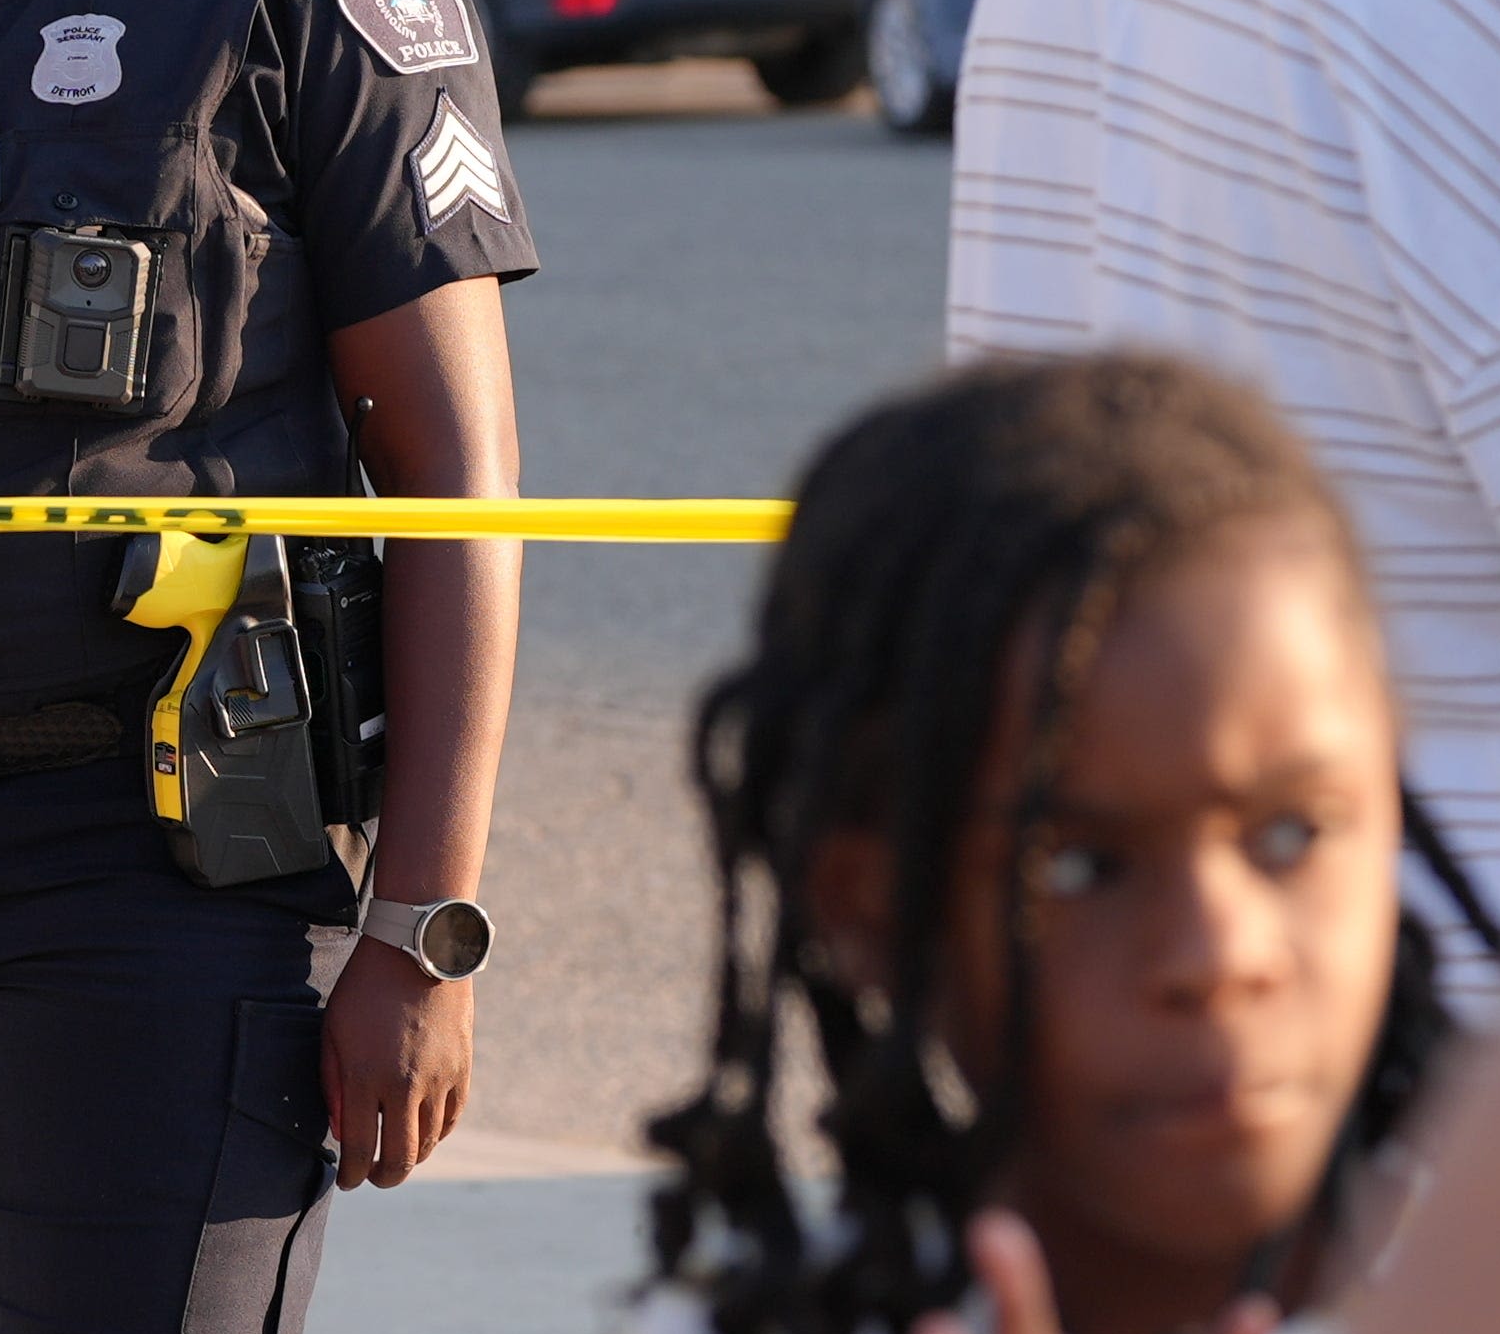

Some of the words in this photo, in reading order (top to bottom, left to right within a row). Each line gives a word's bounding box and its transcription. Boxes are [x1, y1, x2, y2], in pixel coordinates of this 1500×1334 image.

[63, 26, 101, 35] POLICE
[56, 33, 106, 43] SERGEANT
[398, 40, 464, 62] POLICE
[51, 84, 96, 98] DETROIT
